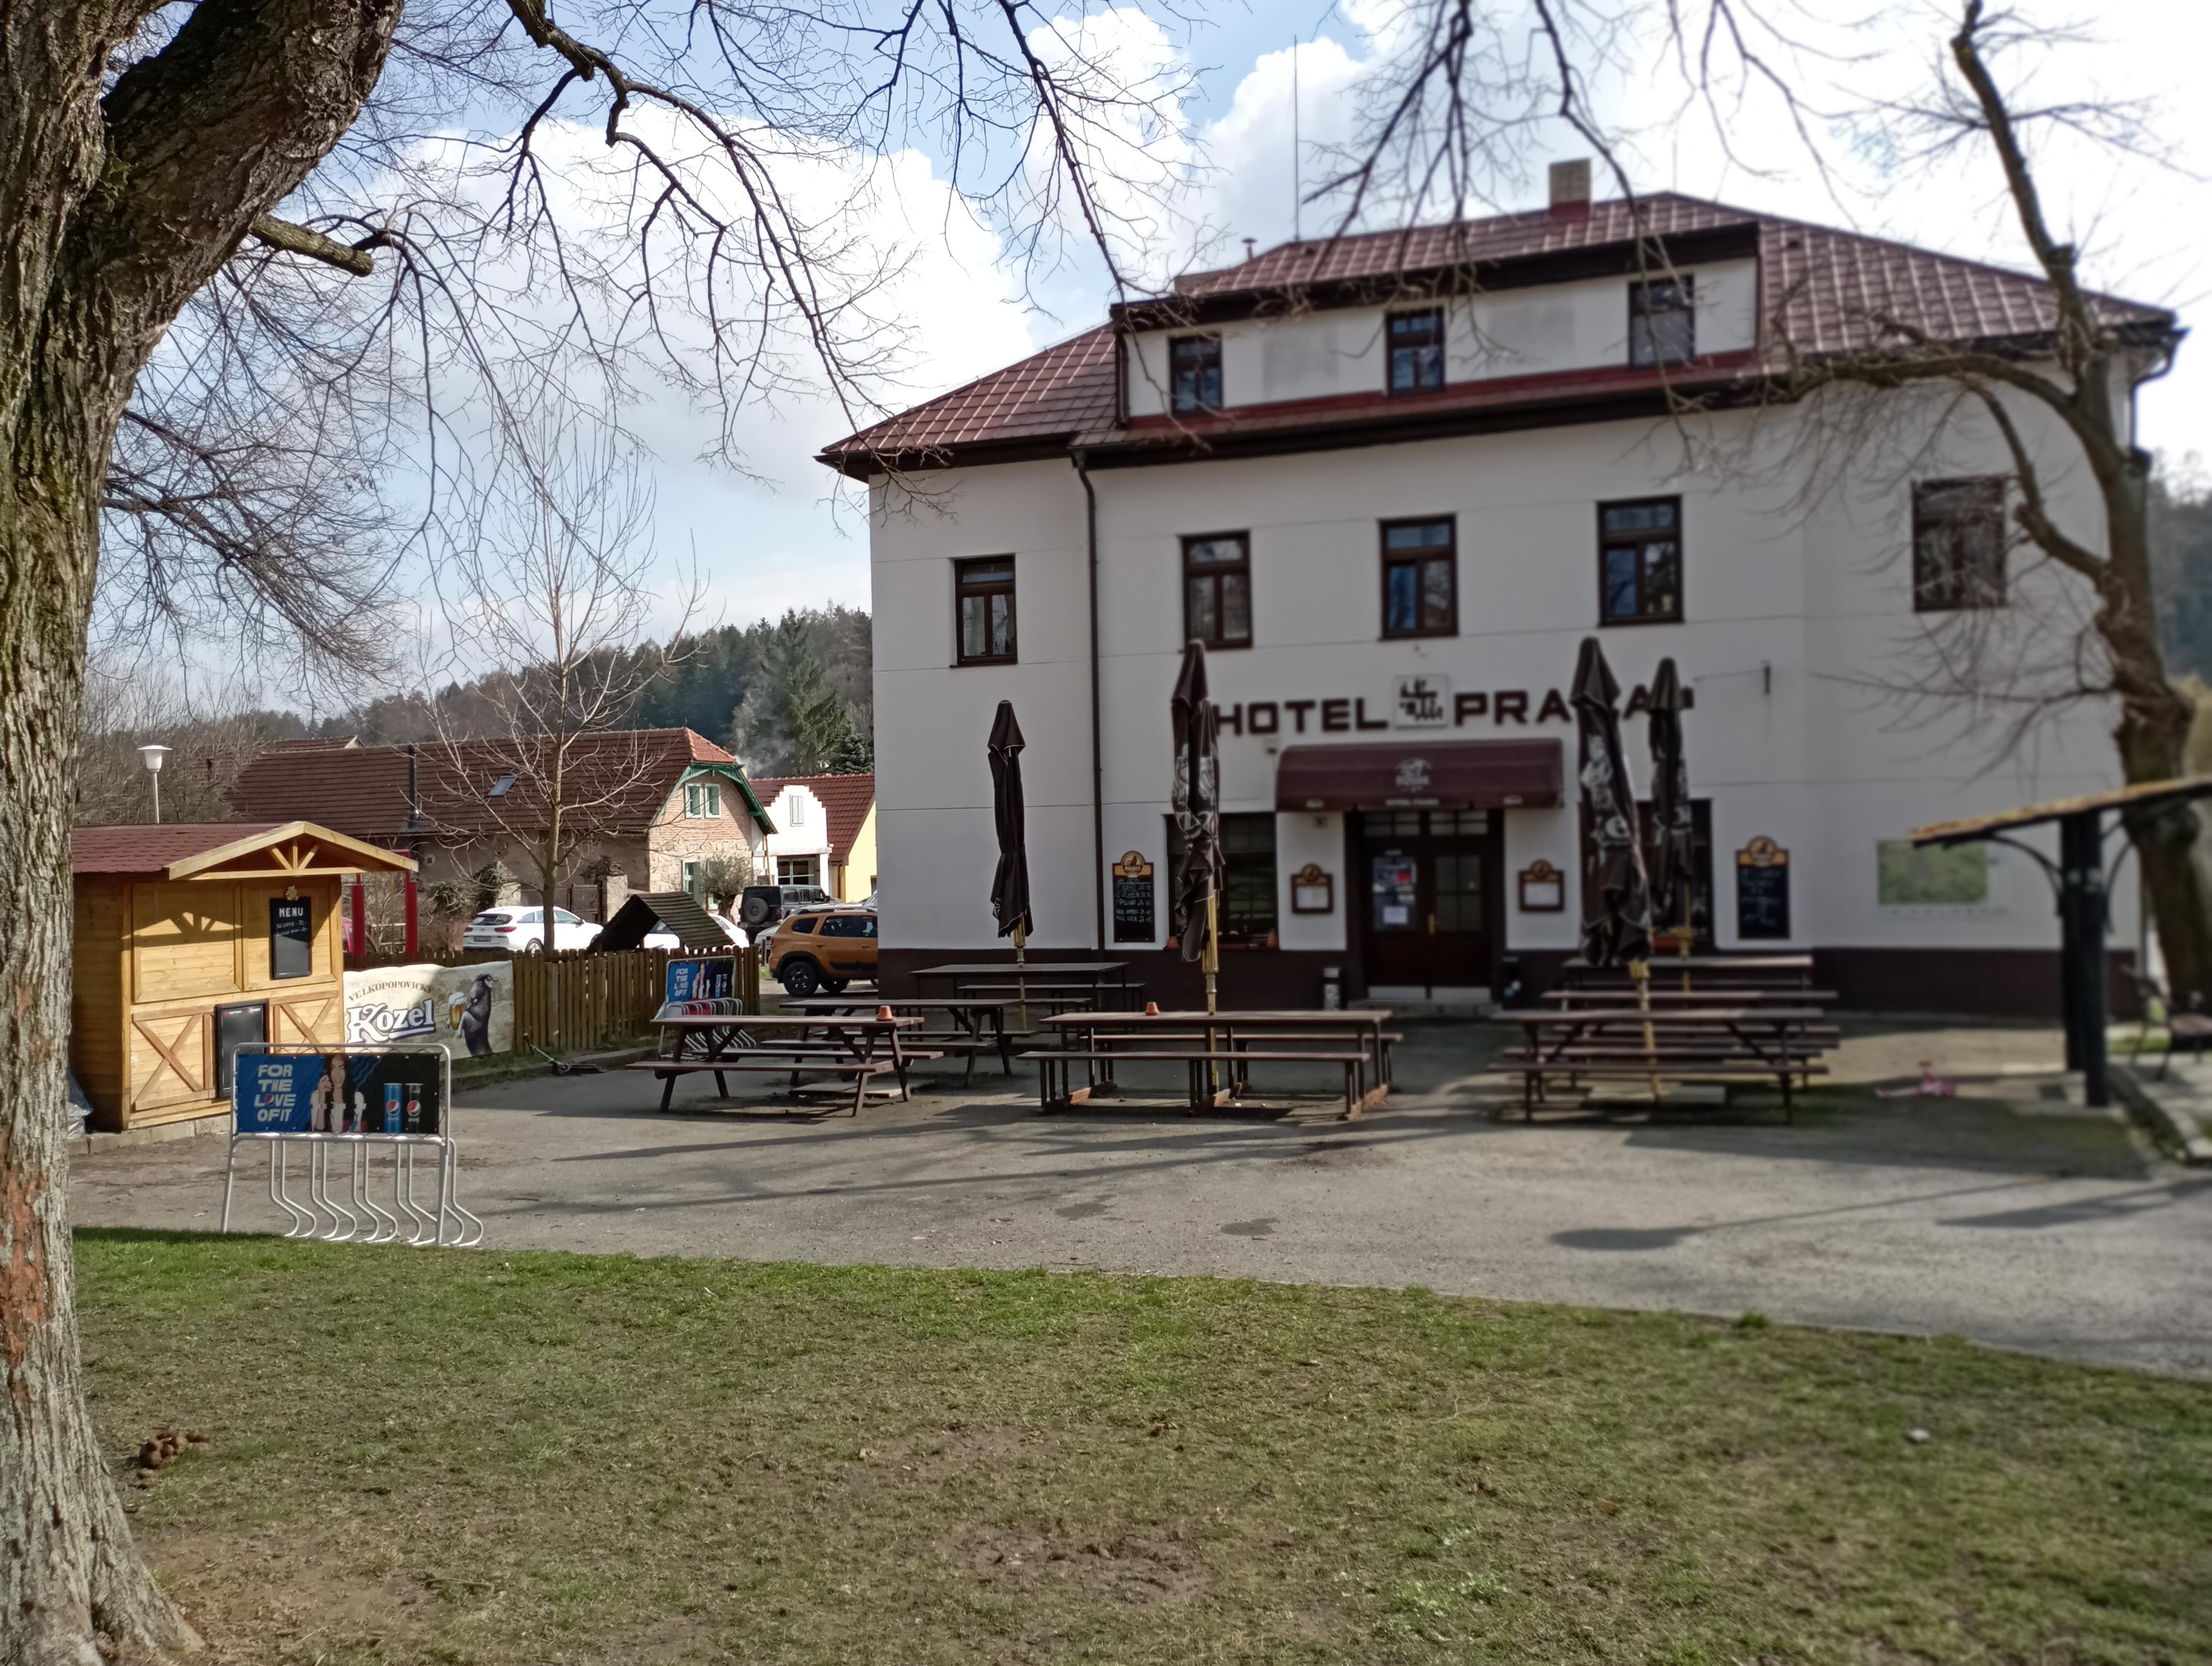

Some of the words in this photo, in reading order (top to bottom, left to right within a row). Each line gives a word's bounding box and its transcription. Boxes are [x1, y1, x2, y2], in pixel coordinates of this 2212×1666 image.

[1213, 696, 1389, 737] HOTEL
[1452, 683, 1656, 727] PRAA
[279, 907, 304, 918] MENU
[346, 998, 435, 1044] Kozel
[257, 1063, 293, 1077] FOR
